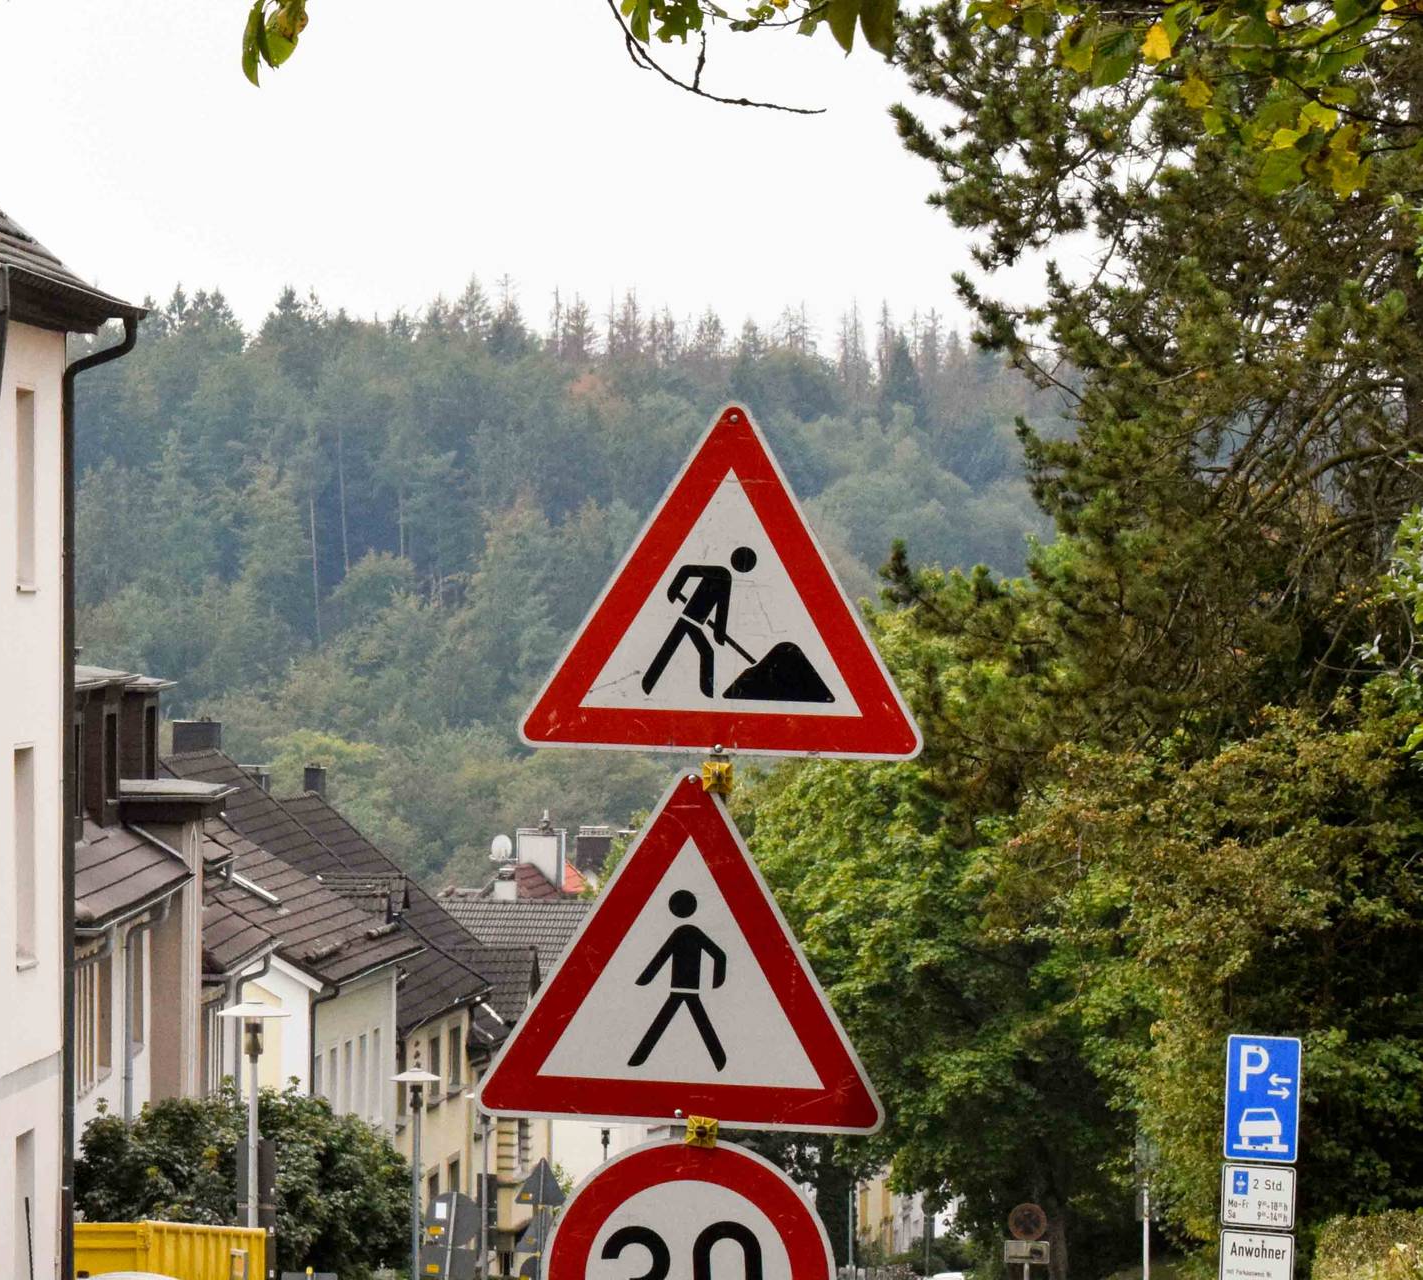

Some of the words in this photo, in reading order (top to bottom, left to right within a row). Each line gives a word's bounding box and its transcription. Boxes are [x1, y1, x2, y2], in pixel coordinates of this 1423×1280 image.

[1239, 1045, 1270, 1092] P
[1253, 1178, 1259, 1190] 2
[1227, 1199, 1249, 1208] Mo-Fr
[1227, 1209, 1236, 1219] Sa
[1230, 1241, 1287, 1260] Anwohner
